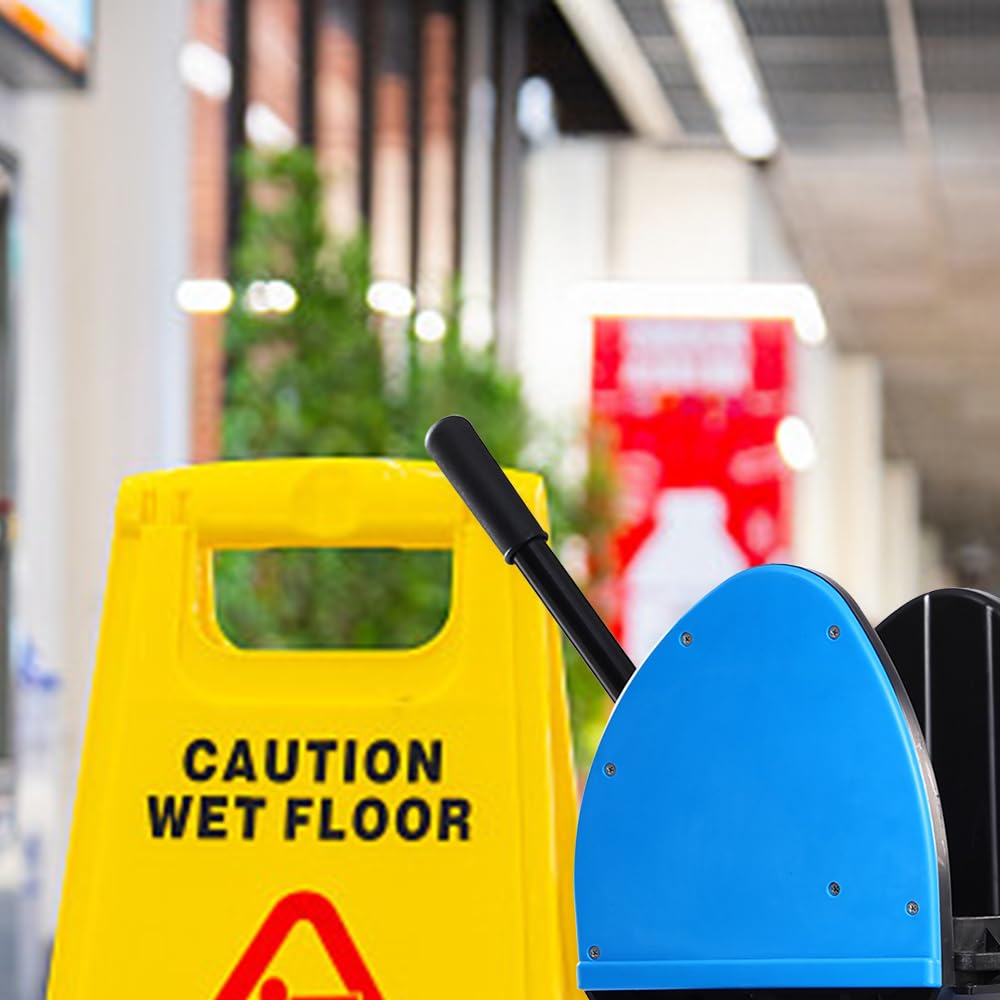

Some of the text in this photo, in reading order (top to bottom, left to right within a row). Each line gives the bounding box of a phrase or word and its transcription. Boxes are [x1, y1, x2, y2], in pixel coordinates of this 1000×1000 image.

[183, 738, 443, 783] CAUTION
[148, 795, 471, 841] WET FLOOR
